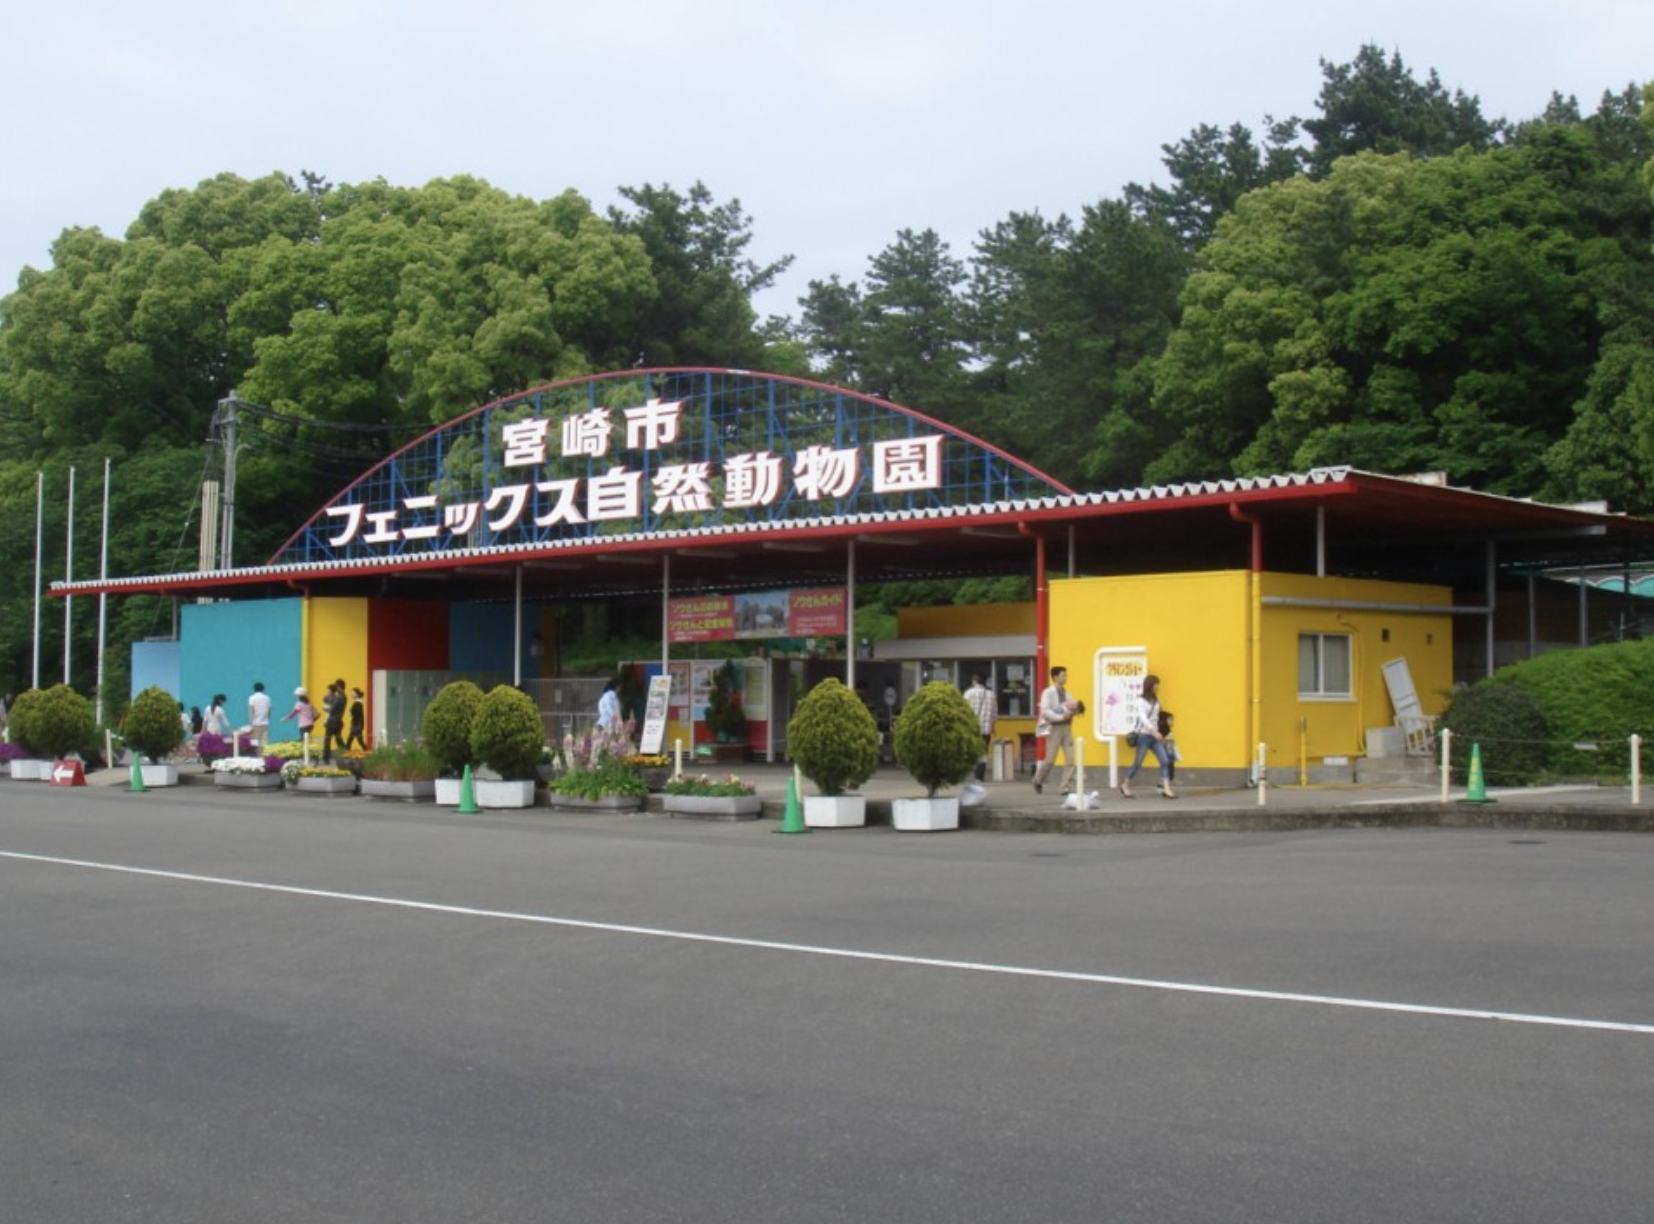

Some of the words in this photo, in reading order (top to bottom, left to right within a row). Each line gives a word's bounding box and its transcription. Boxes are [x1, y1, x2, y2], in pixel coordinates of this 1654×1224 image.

[502, 398, 684, 467] 宮崎市
[326, 433, 945, 547] フェニックス自然動物園
